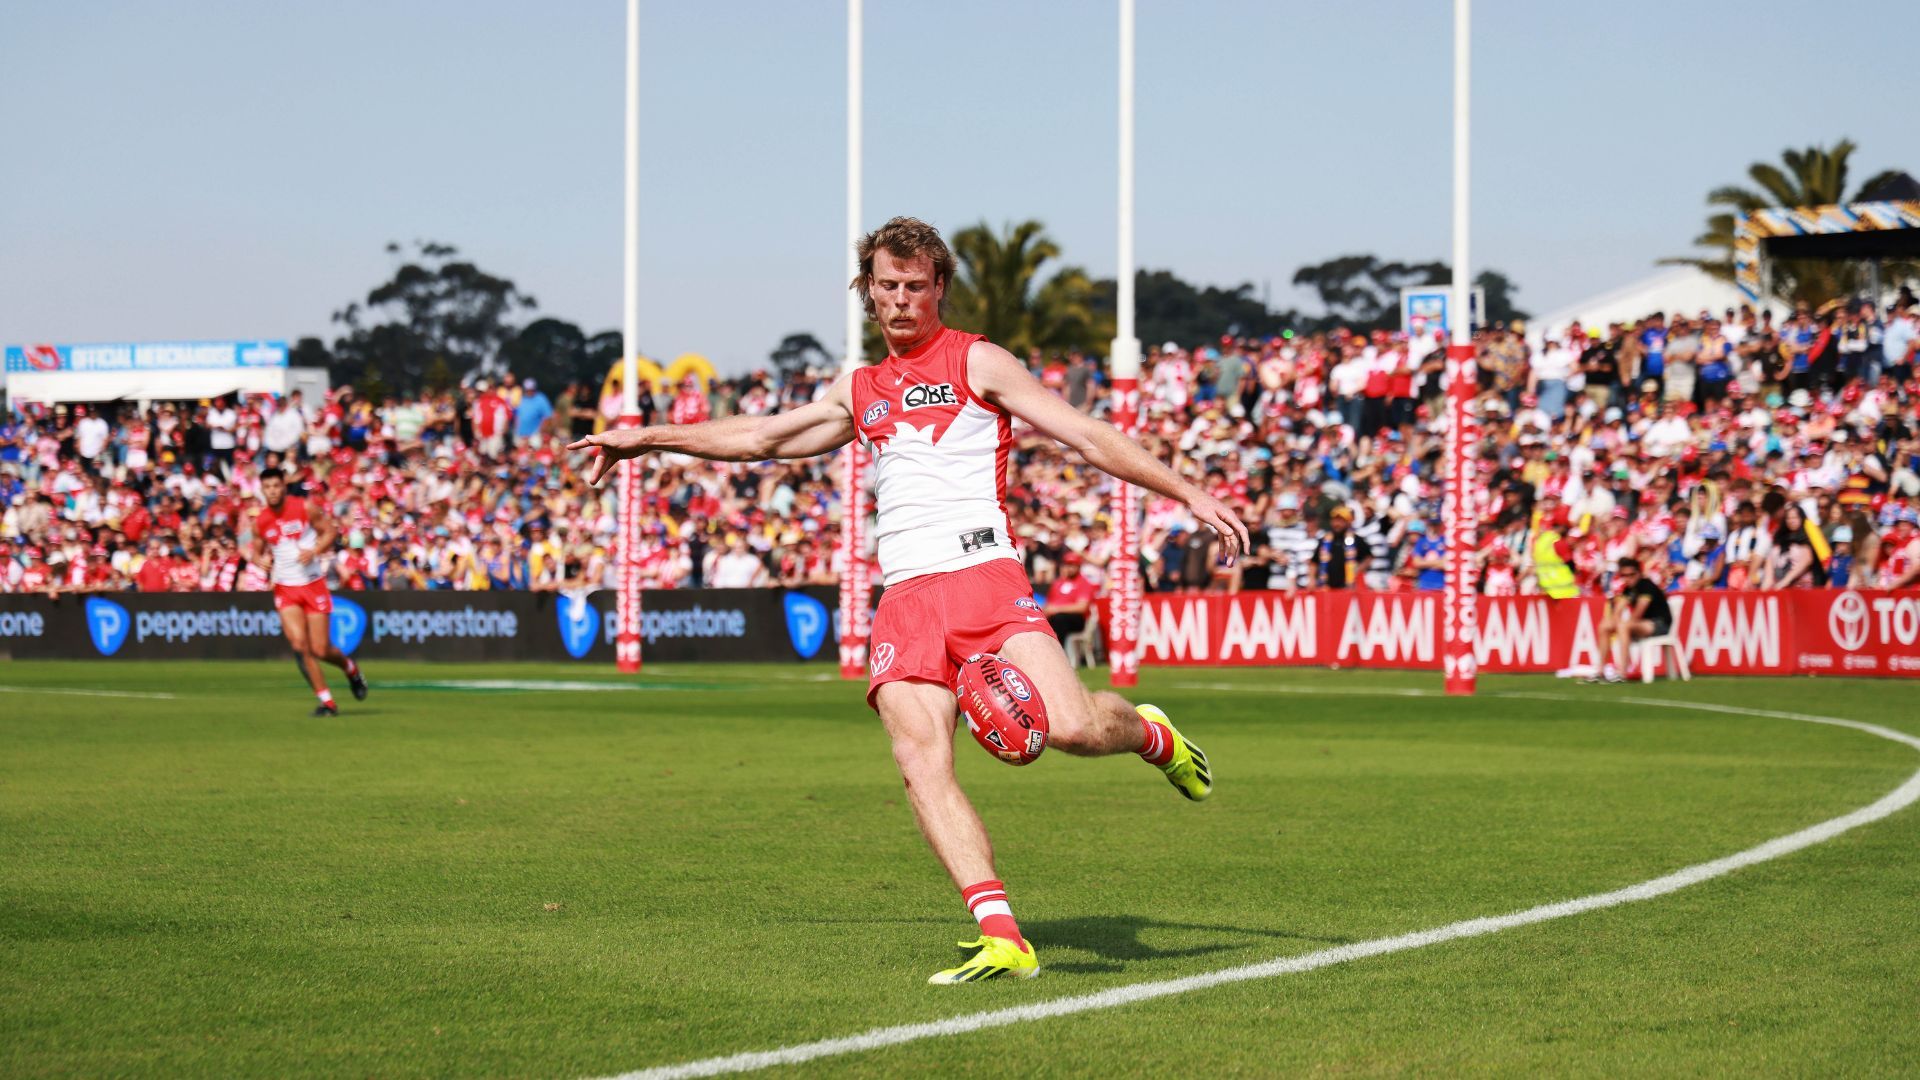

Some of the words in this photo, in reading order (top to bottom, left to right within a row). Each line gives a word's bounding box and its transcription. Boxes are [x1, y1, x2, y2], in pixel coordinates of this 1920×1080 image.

[866, 404, 888, 424] AFL
[905, 385, 956, 408] QBE
[136, 605, 282, 643] pepperstone
[373, 605, 517, 643] pepperstone
[1136, 598, 1208, 661] AMI
[1220, 596, 1317, 660] AAMI
[1338, 596, 1435, 662] AAMI
[1684, 596, 1780, 668] AAMI
[1873, 597, 1920, 646] TO
[981, 659, 1035, 730] SHERRIN
[1005, 671, 1030, 697] AFL
